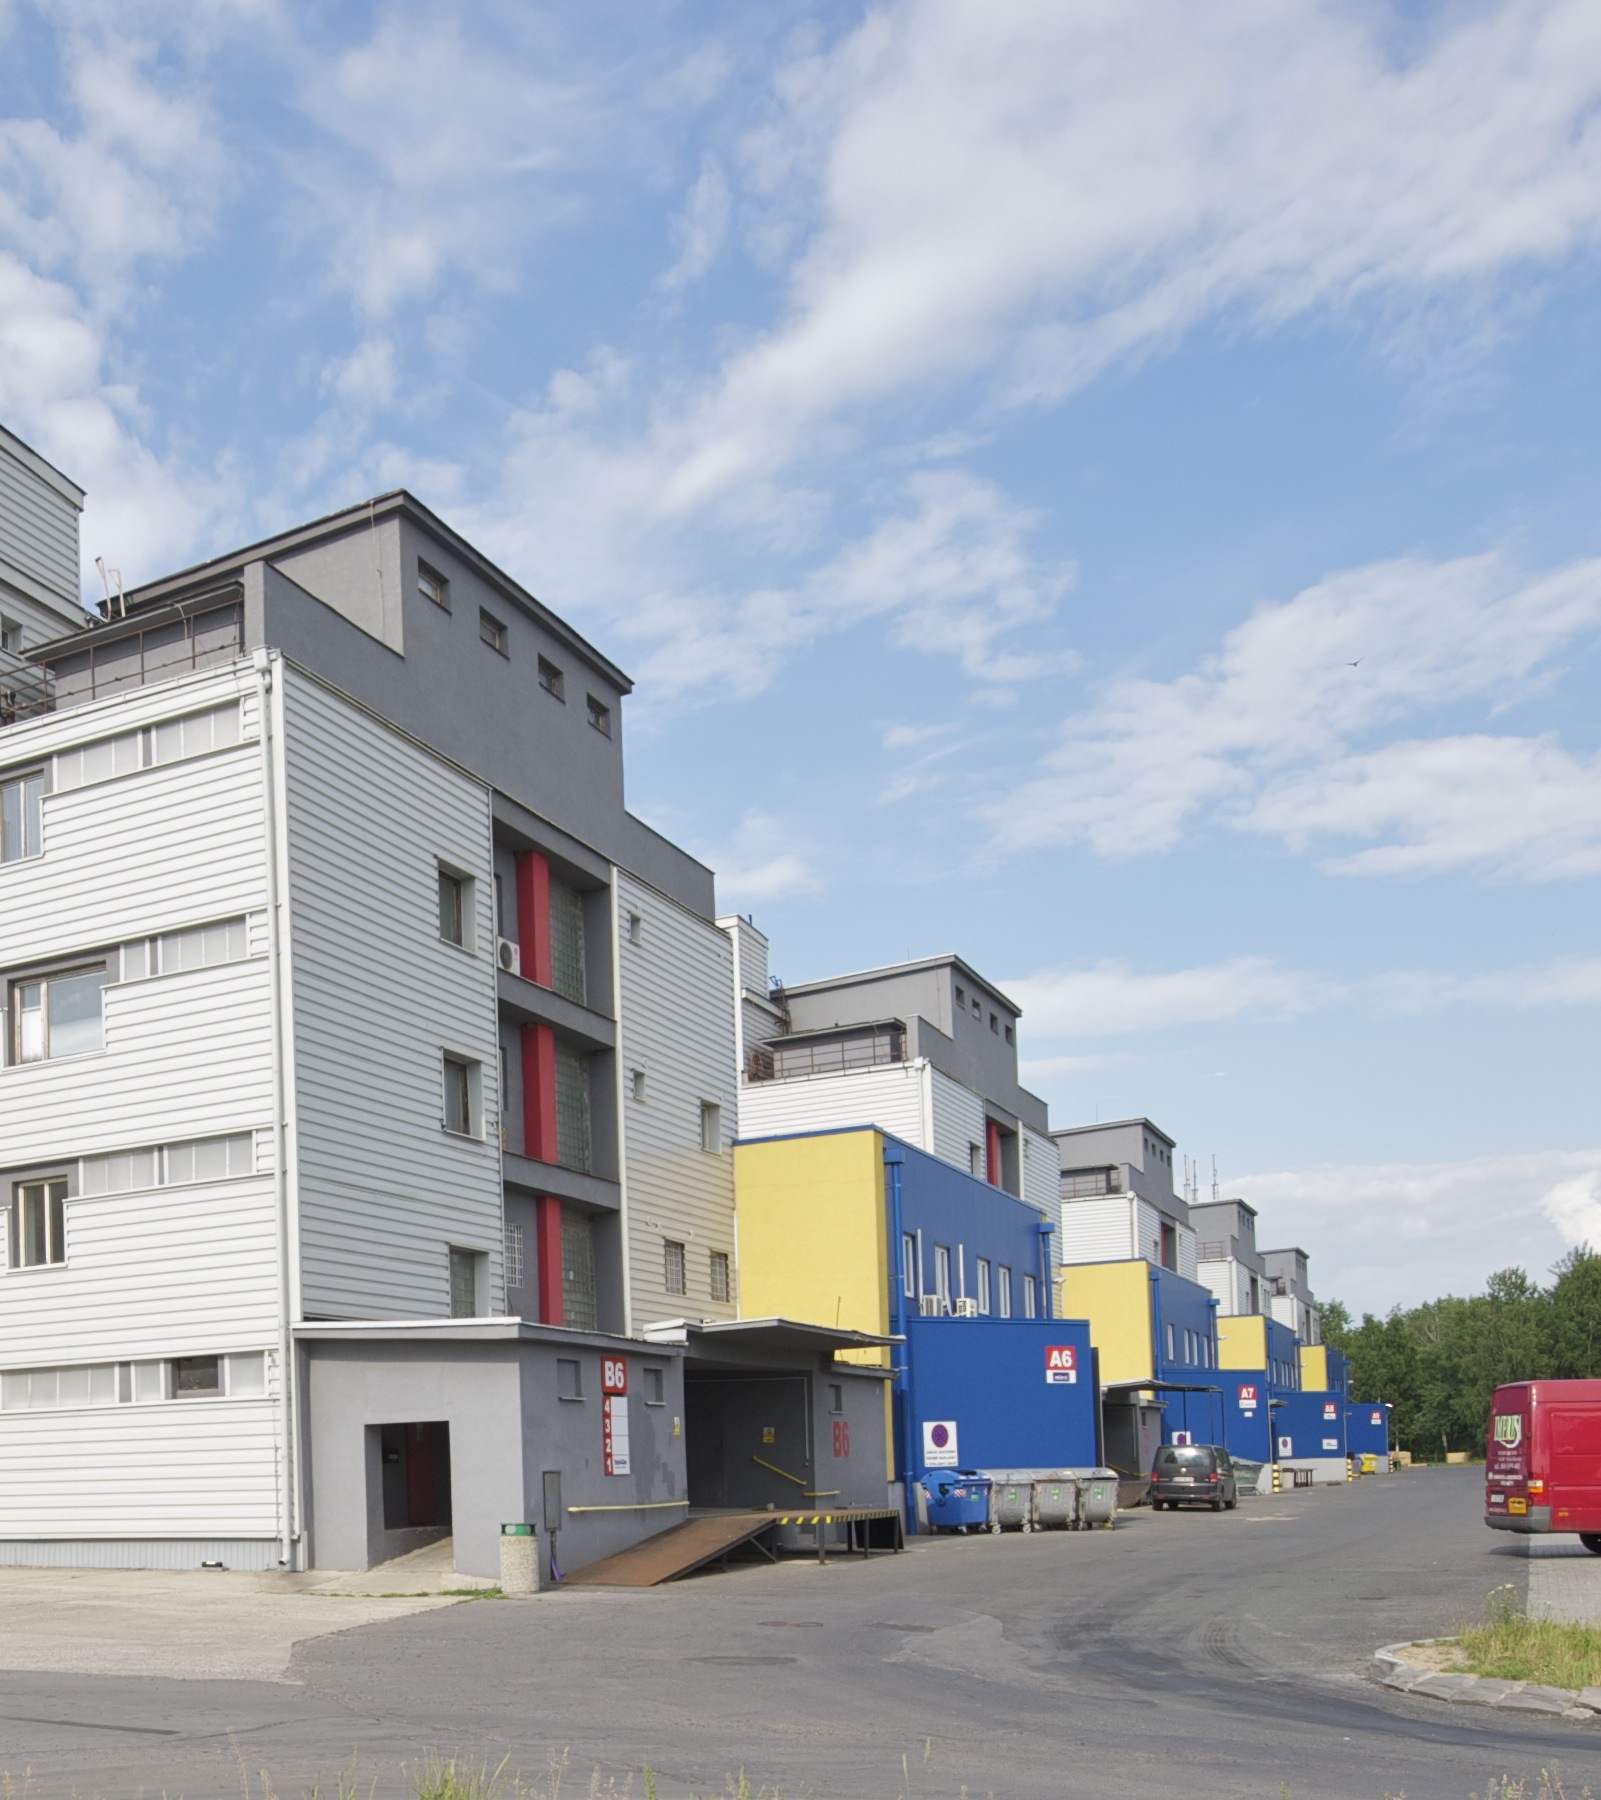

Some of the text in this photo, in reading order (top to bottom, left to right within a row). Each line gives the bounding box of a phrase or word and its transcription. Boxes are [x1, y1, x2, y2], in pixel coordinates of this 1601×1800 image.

[1050, 1350, 1073, 1368] A6
[604, 1360, 625, 1389] B6
[1240, 1387, 1254, 1398] A7
[604, 1400, 611, 1414] 4
[605, 1419, 611, 1433] 3
[605, 1439, 612, 1453] 2
[832, 1421, 849, 1457] B6
[606, 1456, 612, 1473] 1
